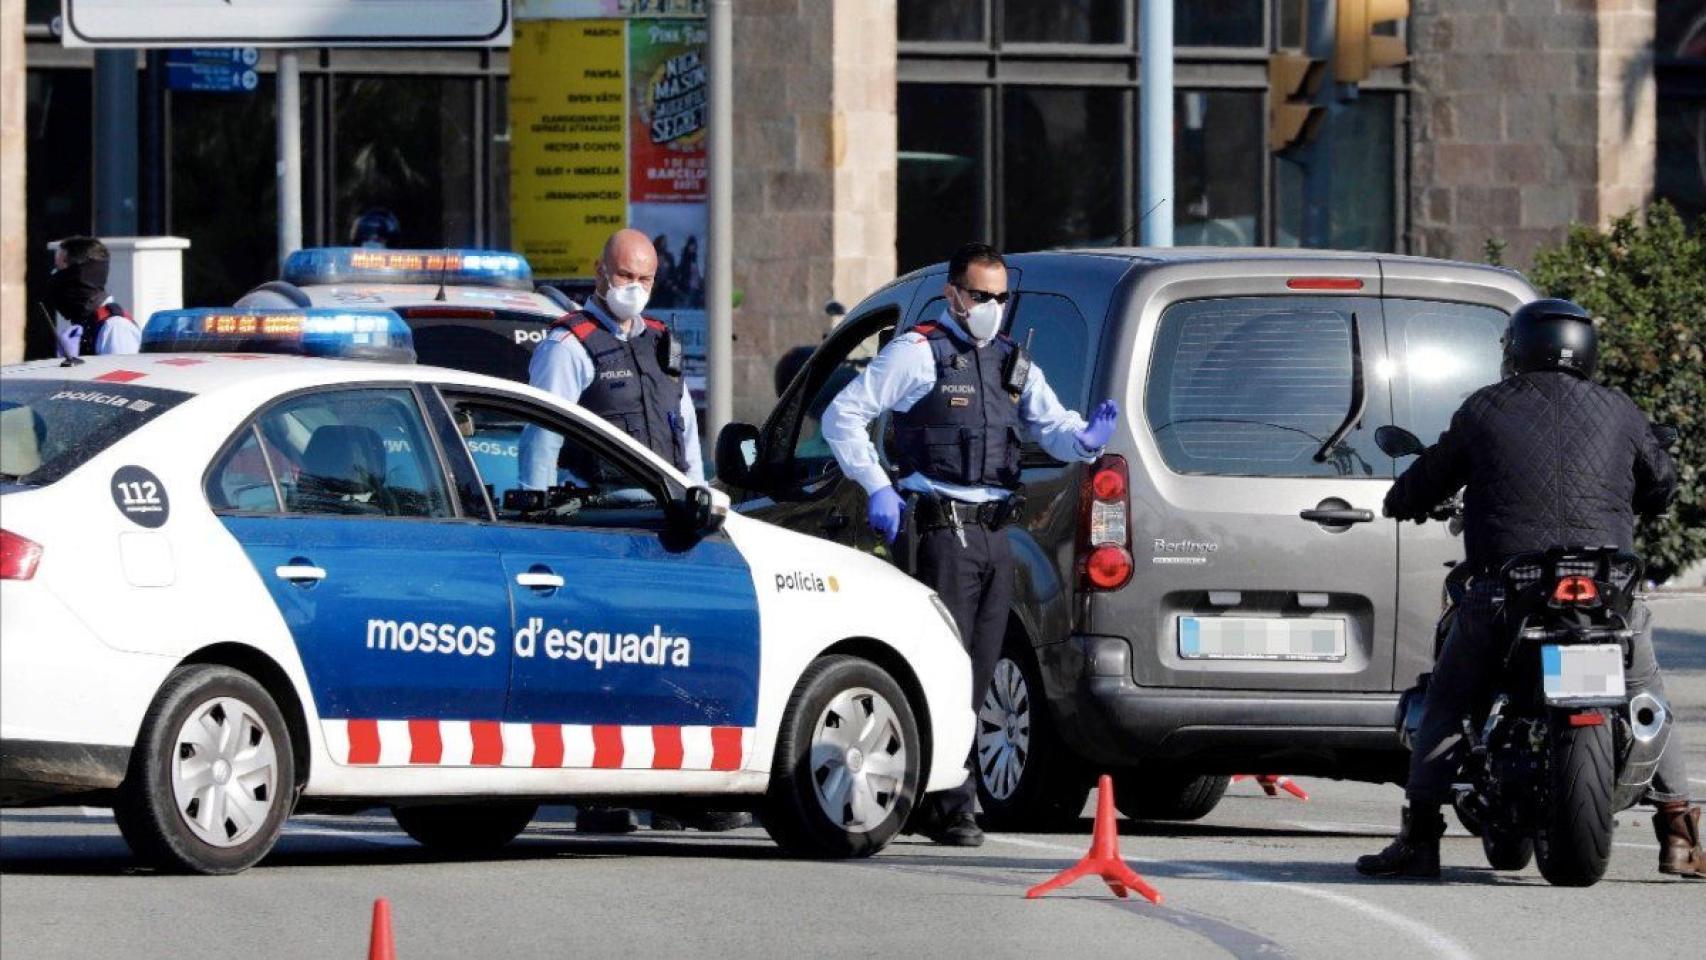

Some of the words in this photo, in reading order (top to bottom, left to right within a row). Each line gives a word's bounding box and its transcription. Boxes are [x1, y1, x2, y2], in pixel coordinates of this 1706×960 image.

[647, 168, 706, 179] BARCELO
[515, 328, 549, 344] pol
[600, 370, 633, 379] POLICIA
[942, 384, 975, 394] POLICIA
[468, 440, 519, 457] sos.c
[117, 481, 160, 505] 112
[1153, 537, 1218, 555] Berlingo
[366, 618, 496, 656] mossos
[514, 617, 690, 669] d'esquadra
